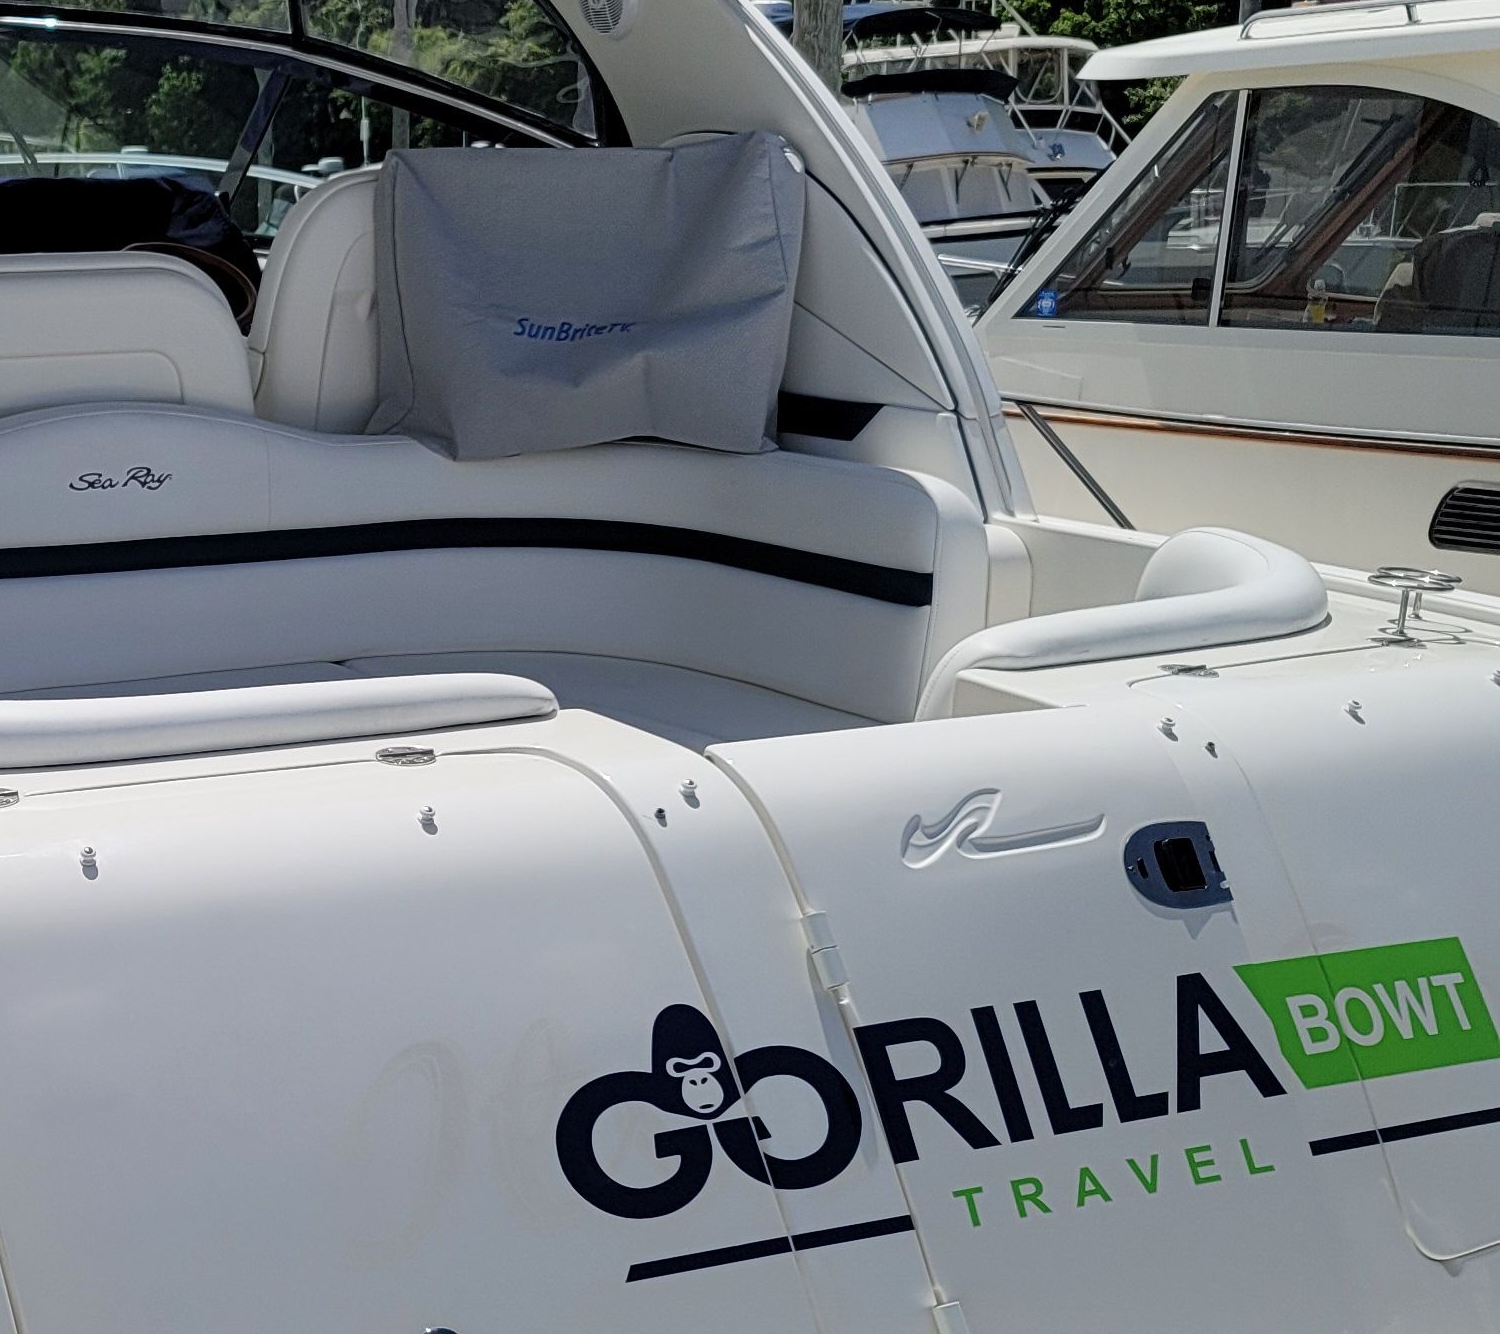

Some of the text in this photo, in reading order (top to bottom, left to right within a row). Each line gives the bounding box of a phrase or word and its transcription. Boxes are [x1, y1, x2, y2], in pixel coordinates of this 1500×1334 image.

[68, 466, 172, 491] Sea Ray
[555, 971, 1475, 1220] GORILLA BOWT
[952, 1137, 1275, 1227] TRAVEL
